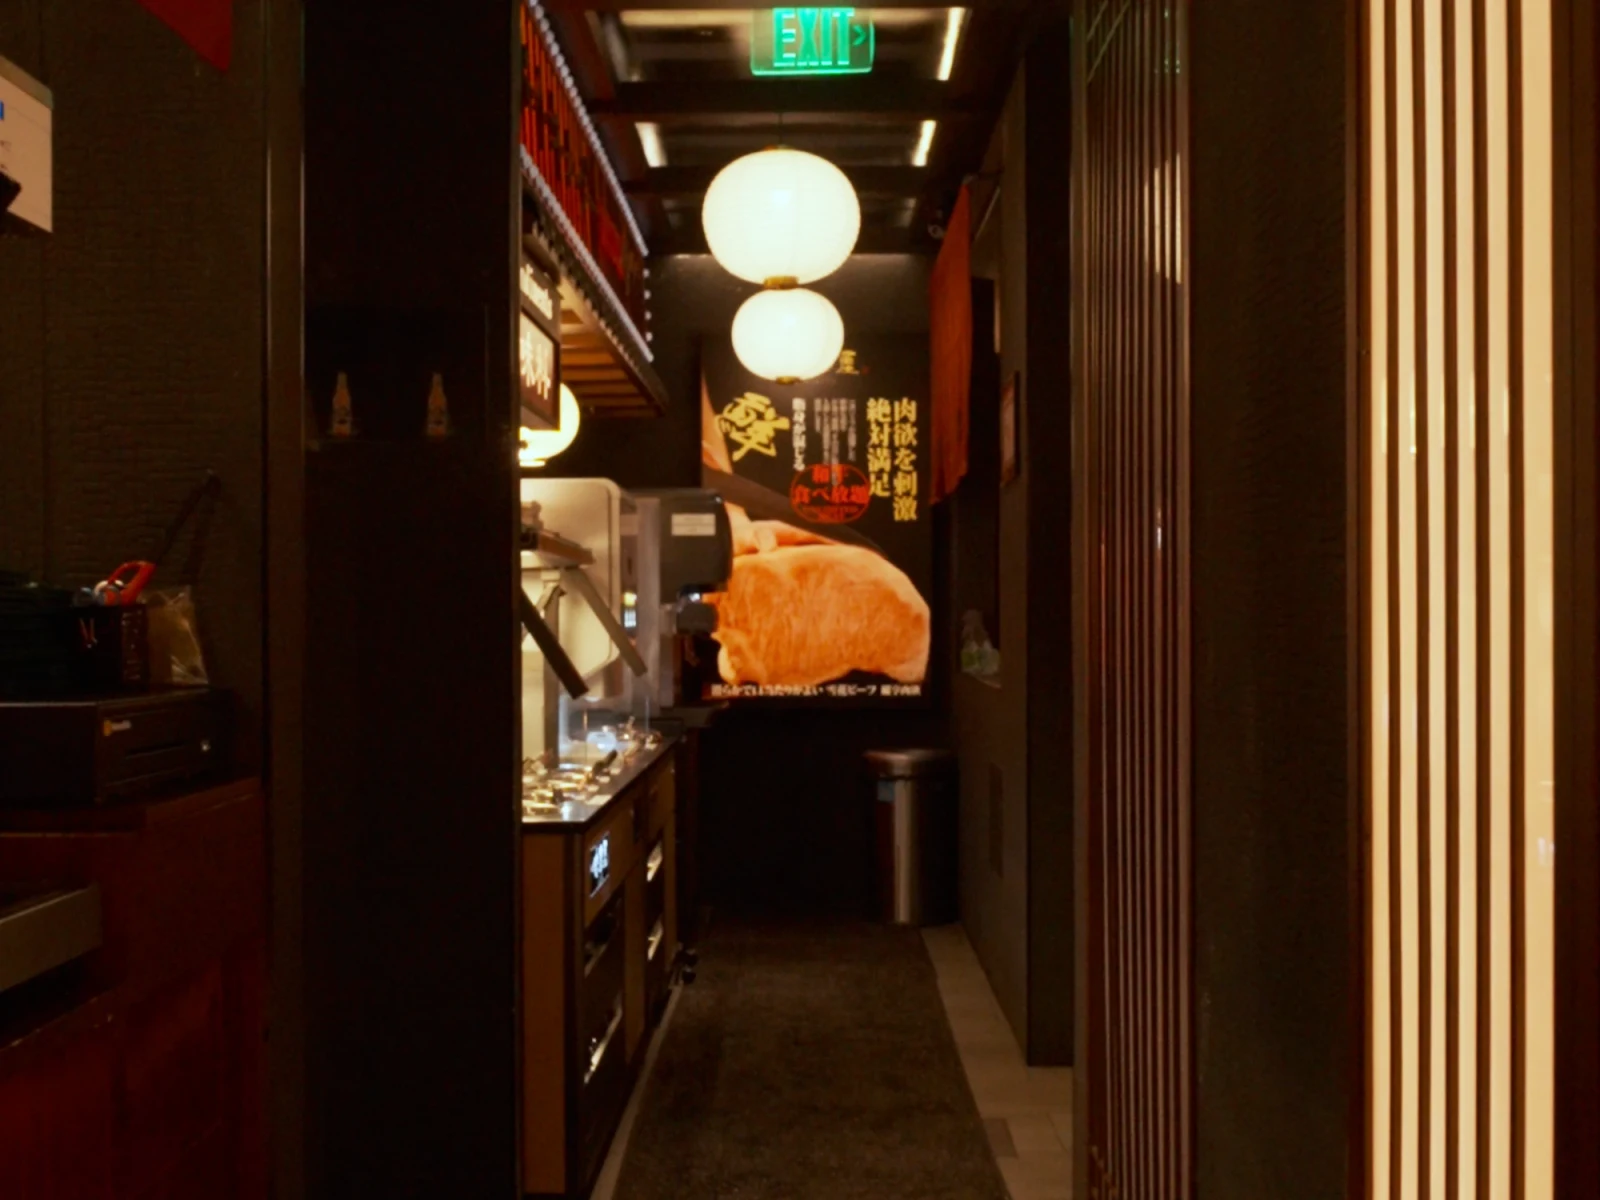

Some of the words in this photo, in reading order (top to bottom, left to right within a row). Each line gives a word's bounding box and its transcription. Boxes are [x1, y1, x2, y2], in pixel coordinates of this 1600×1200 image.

[773, 8, 855, 66] EXIT
[867, 397, 892, 497] 絶対満足
[893, 397, 917, 521] 肉欲を刺激
